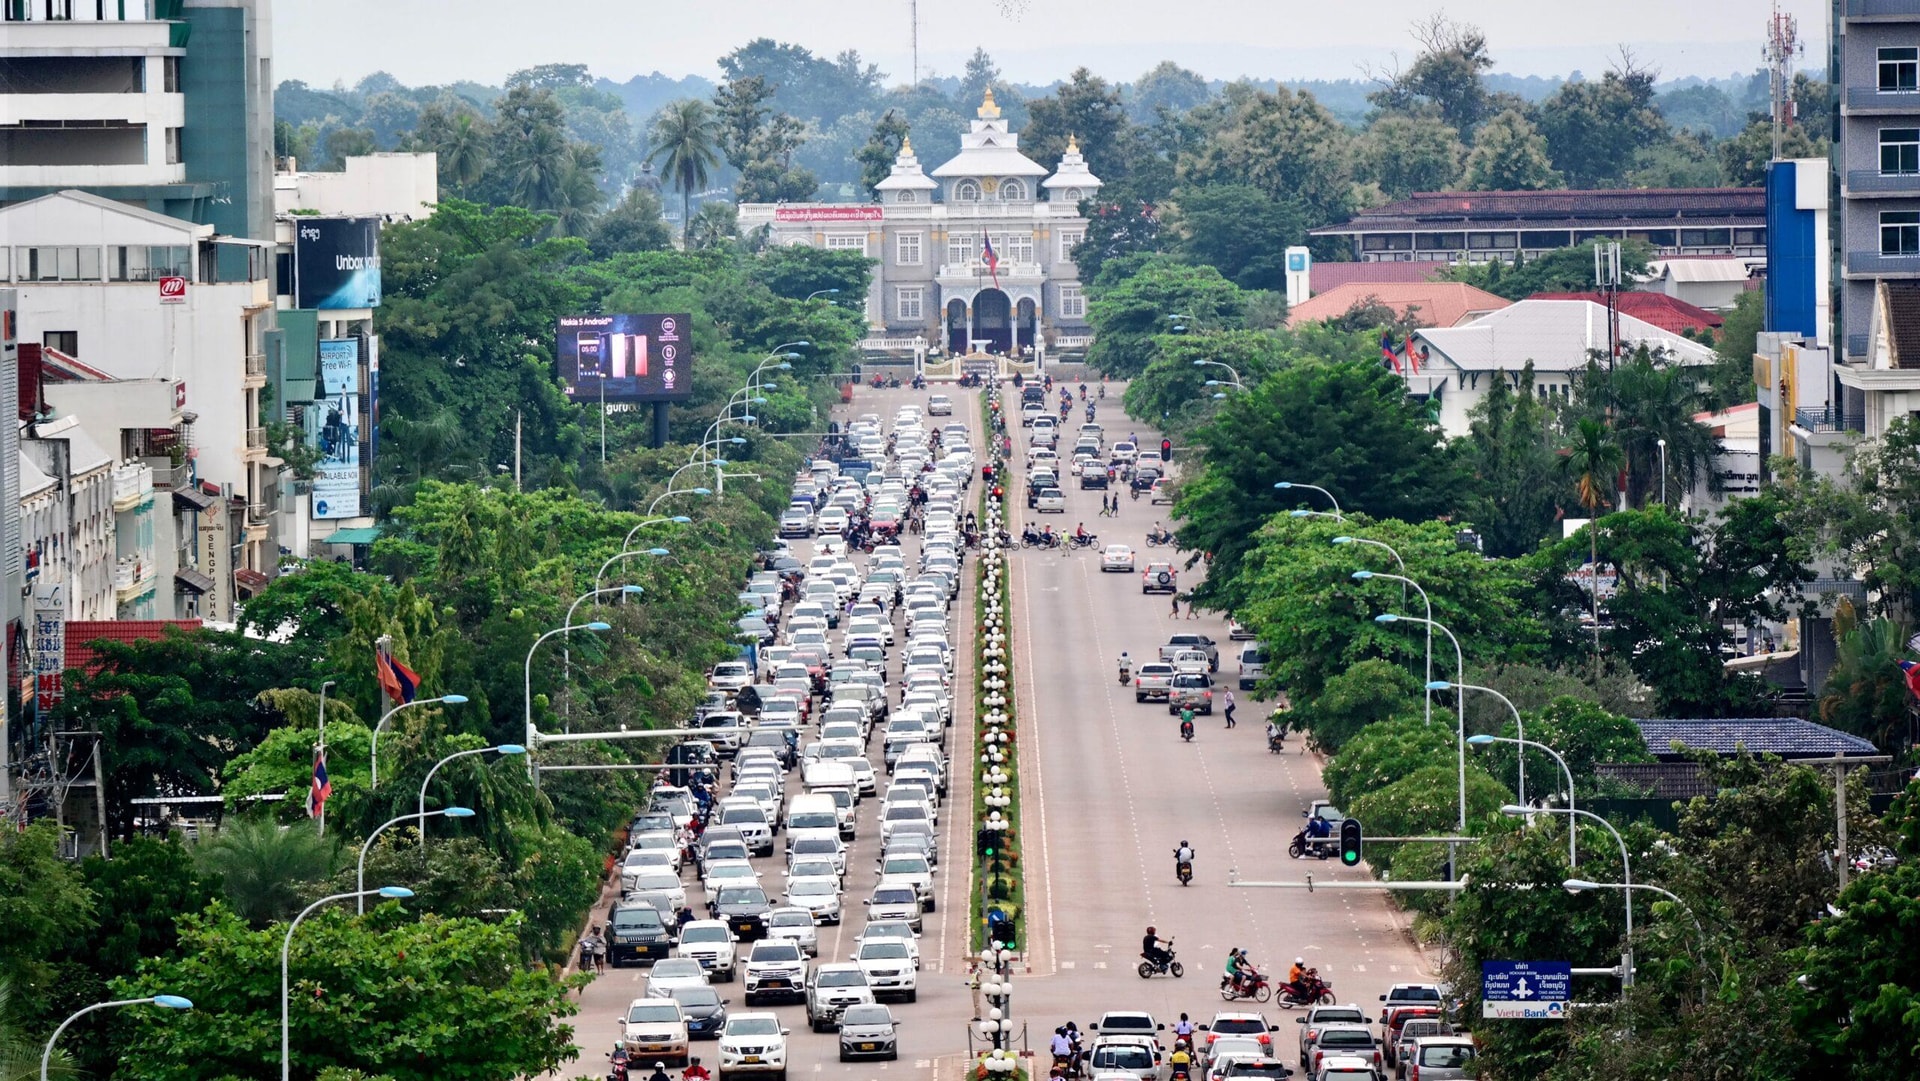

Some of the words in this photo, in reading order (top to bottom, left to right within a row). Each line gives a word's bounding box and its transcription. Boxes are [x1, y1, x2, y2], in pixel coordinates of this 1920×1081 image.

[336, 254, 364, 270] Unbox
[560, 318, 578, 326] Nokia
[578, 318, 584, 326] 5
[321, 352, 346, 360] AIRPORT
[321, 360, 337, 370] Free
[338, 360, 352, 369] Wi-Fi
[208, 534, 216, 621] SENGPHACHA
[1496, 1008, 1548, 1017] VietinBank
